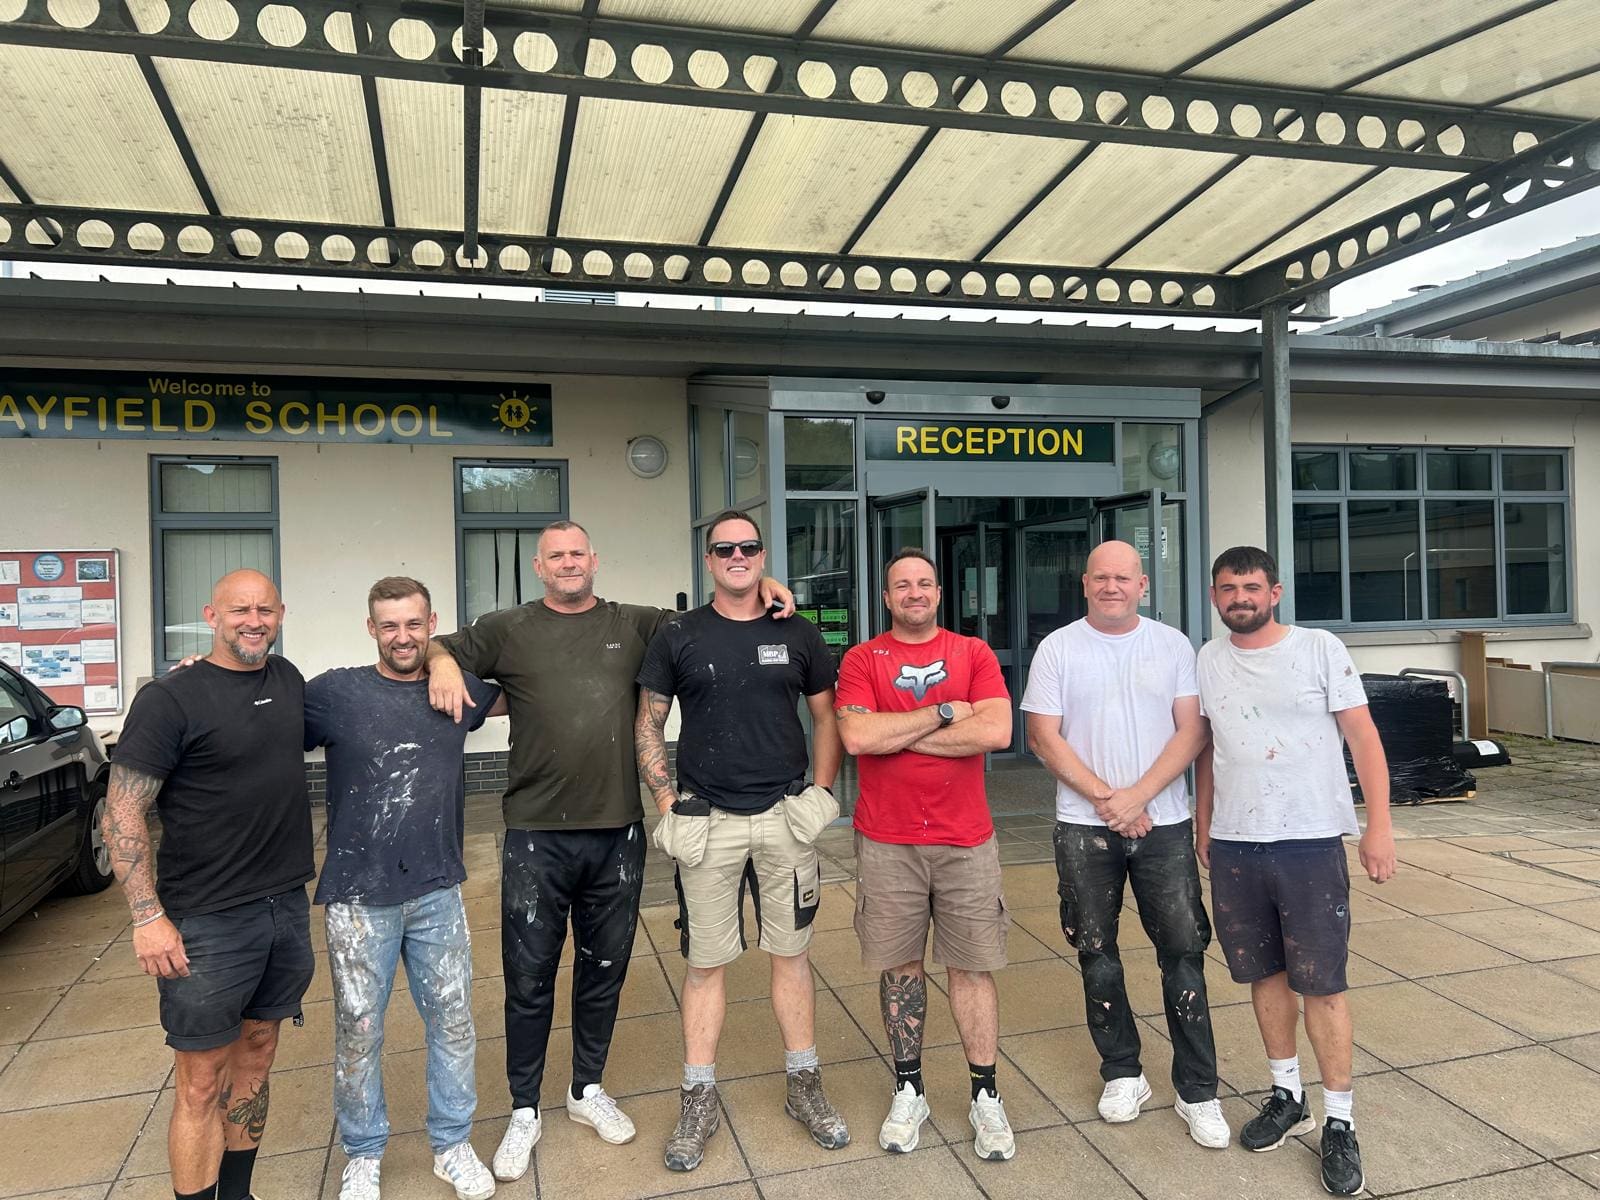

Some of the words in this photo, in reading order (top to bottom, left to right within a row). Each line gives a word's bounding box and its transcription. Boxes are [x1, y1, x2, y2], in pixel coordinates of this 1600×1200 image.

[148, 378, 246, 397] Welcome
[252, 381, 271, 397] to
[245, 401, 453, 437] SCHOOL
[896, 426, 1083, 456] RECEPTION
